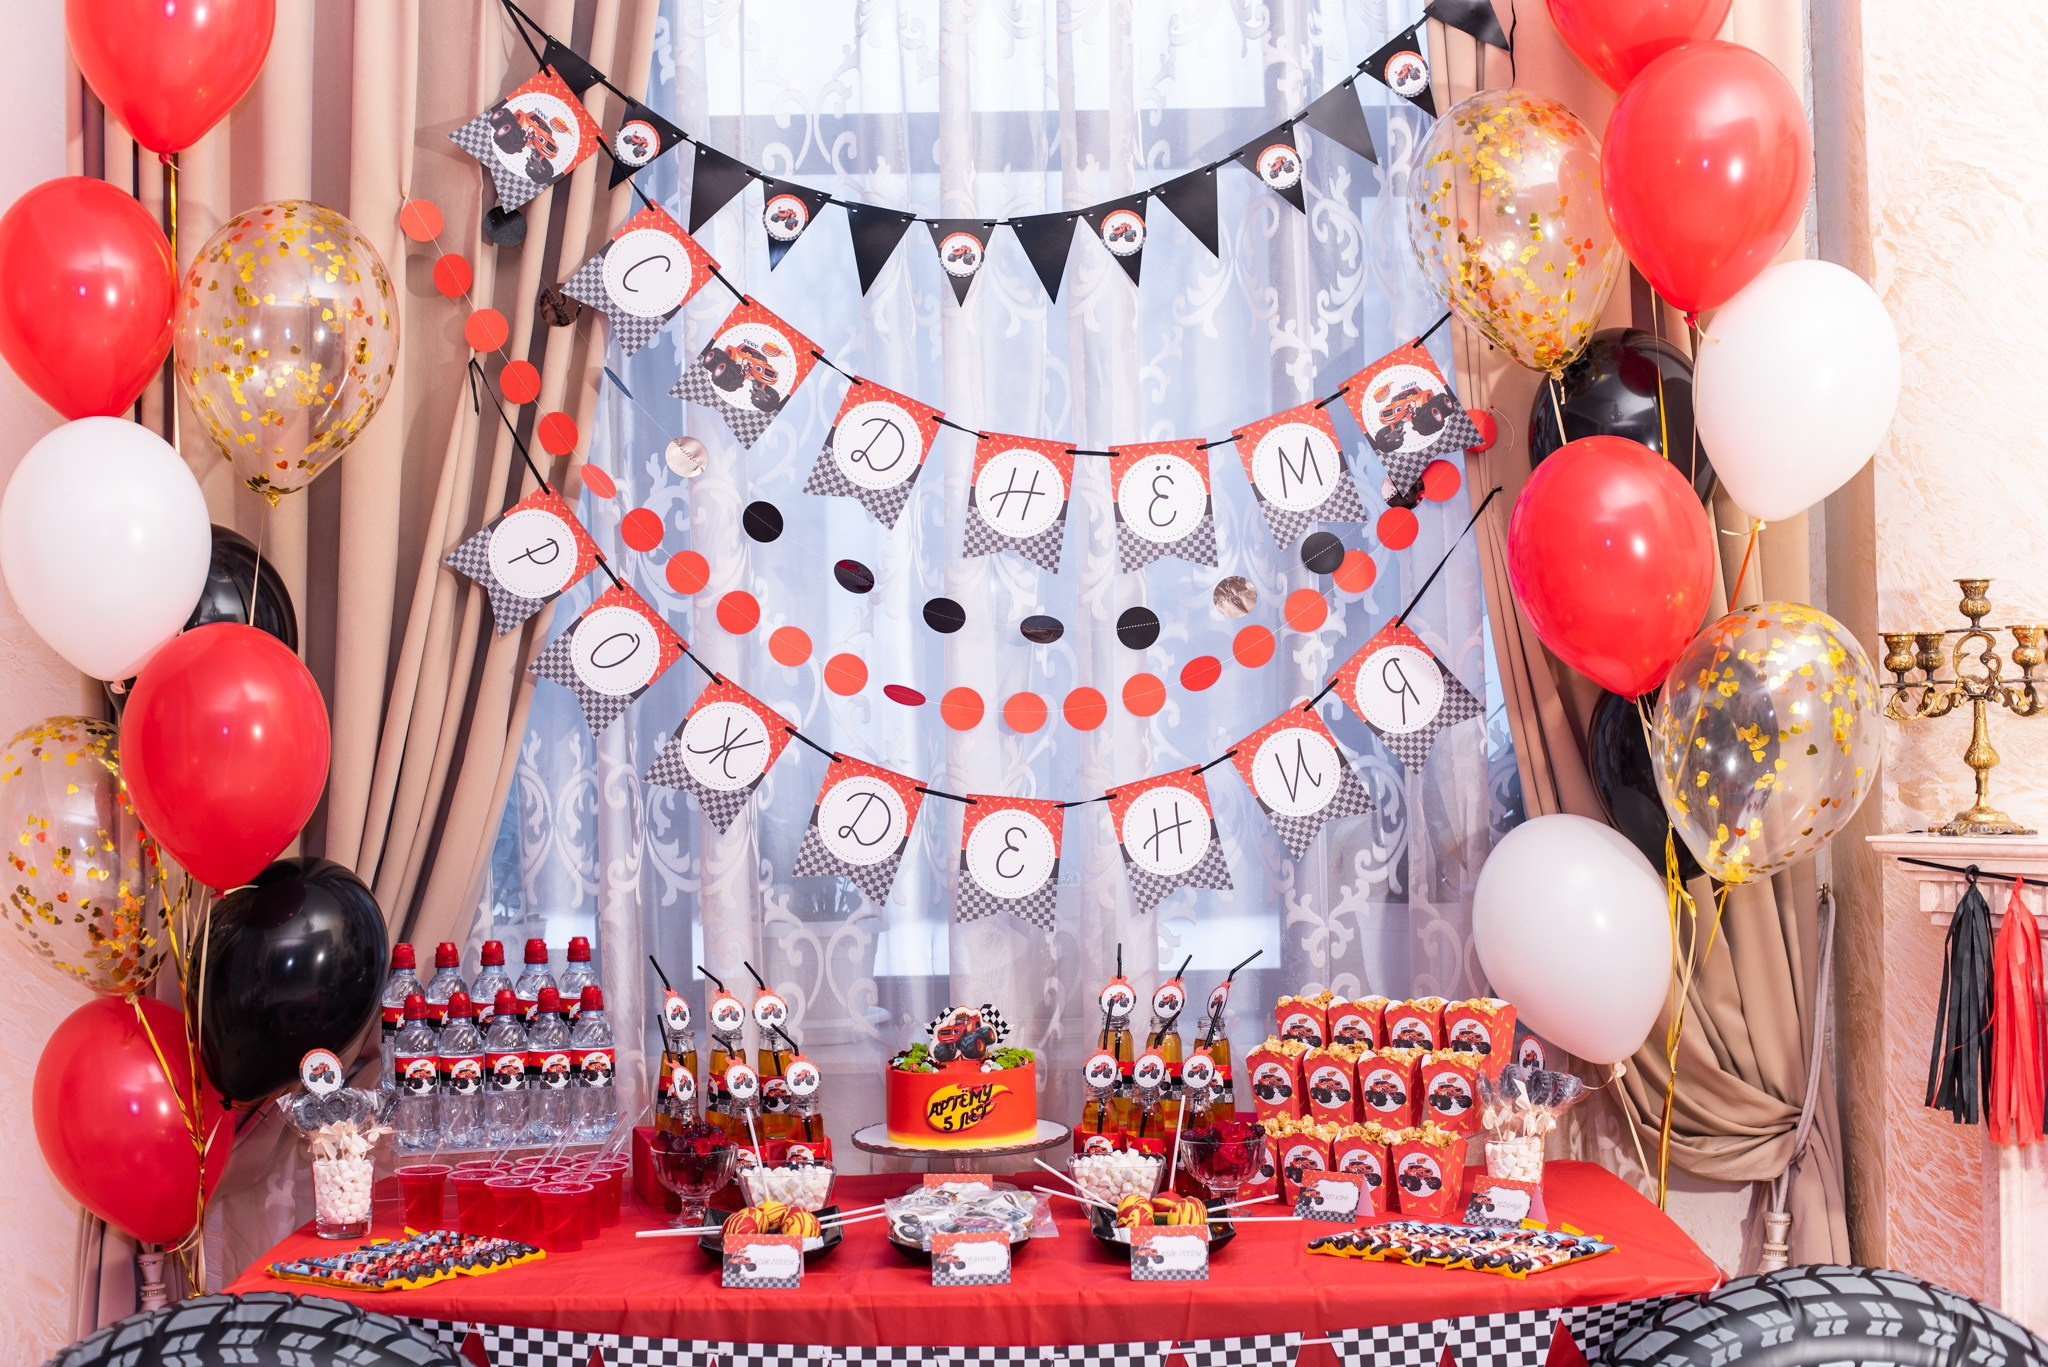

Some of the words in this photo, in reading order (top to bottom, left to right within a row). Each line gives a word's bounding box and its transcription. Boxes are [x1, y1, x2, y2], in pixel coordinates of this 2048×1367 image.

[622, 254, 671, 294] С
[927, 1084, 993, 1119] АРТЁМУ
[943, 1115, 953, 1131] 5
[957, 1101, 992, 1131] ЛЕТ
